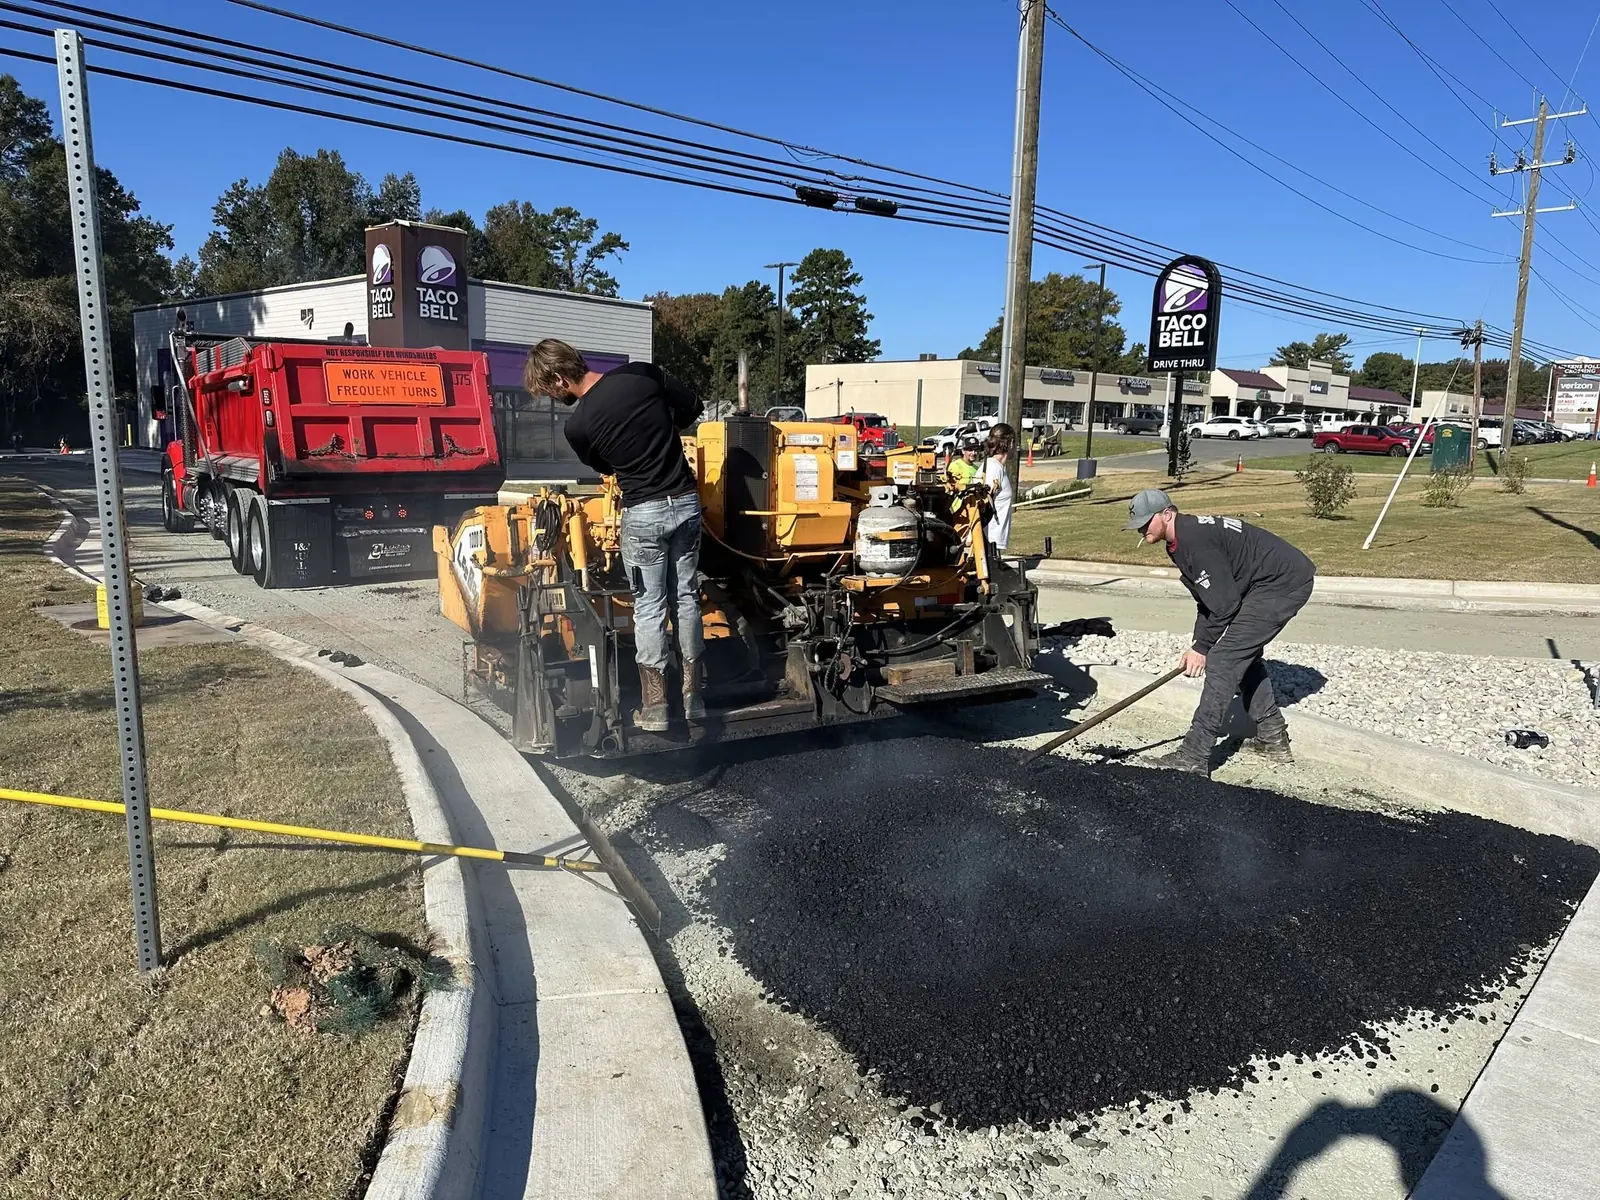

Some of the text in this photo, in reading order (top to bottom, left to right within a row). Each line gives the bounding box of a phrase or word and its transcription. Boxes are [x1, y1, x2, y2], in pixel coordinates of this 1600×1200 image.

[370, 287, 393, 304] TACO
[416, 287, 459, 305] TACO
[372, 303, 393, 319] BELL
[420, 304, 458, 321] BELL
[1157, 313, 1207, 332] TACO
[1158, 330, 1204, 347] BELL
[325, 348, 437, 360] NOT RESPONSIBLE FOR WINDSHIELDS
[1153, 359, 1205, 369] DRIVE THRU
[342, 369, 427, 381] WORK VEHICLE
[337, 385, 438, 398] FREQUENT TURNS
[1560, 382, 1593, 390] verizon
